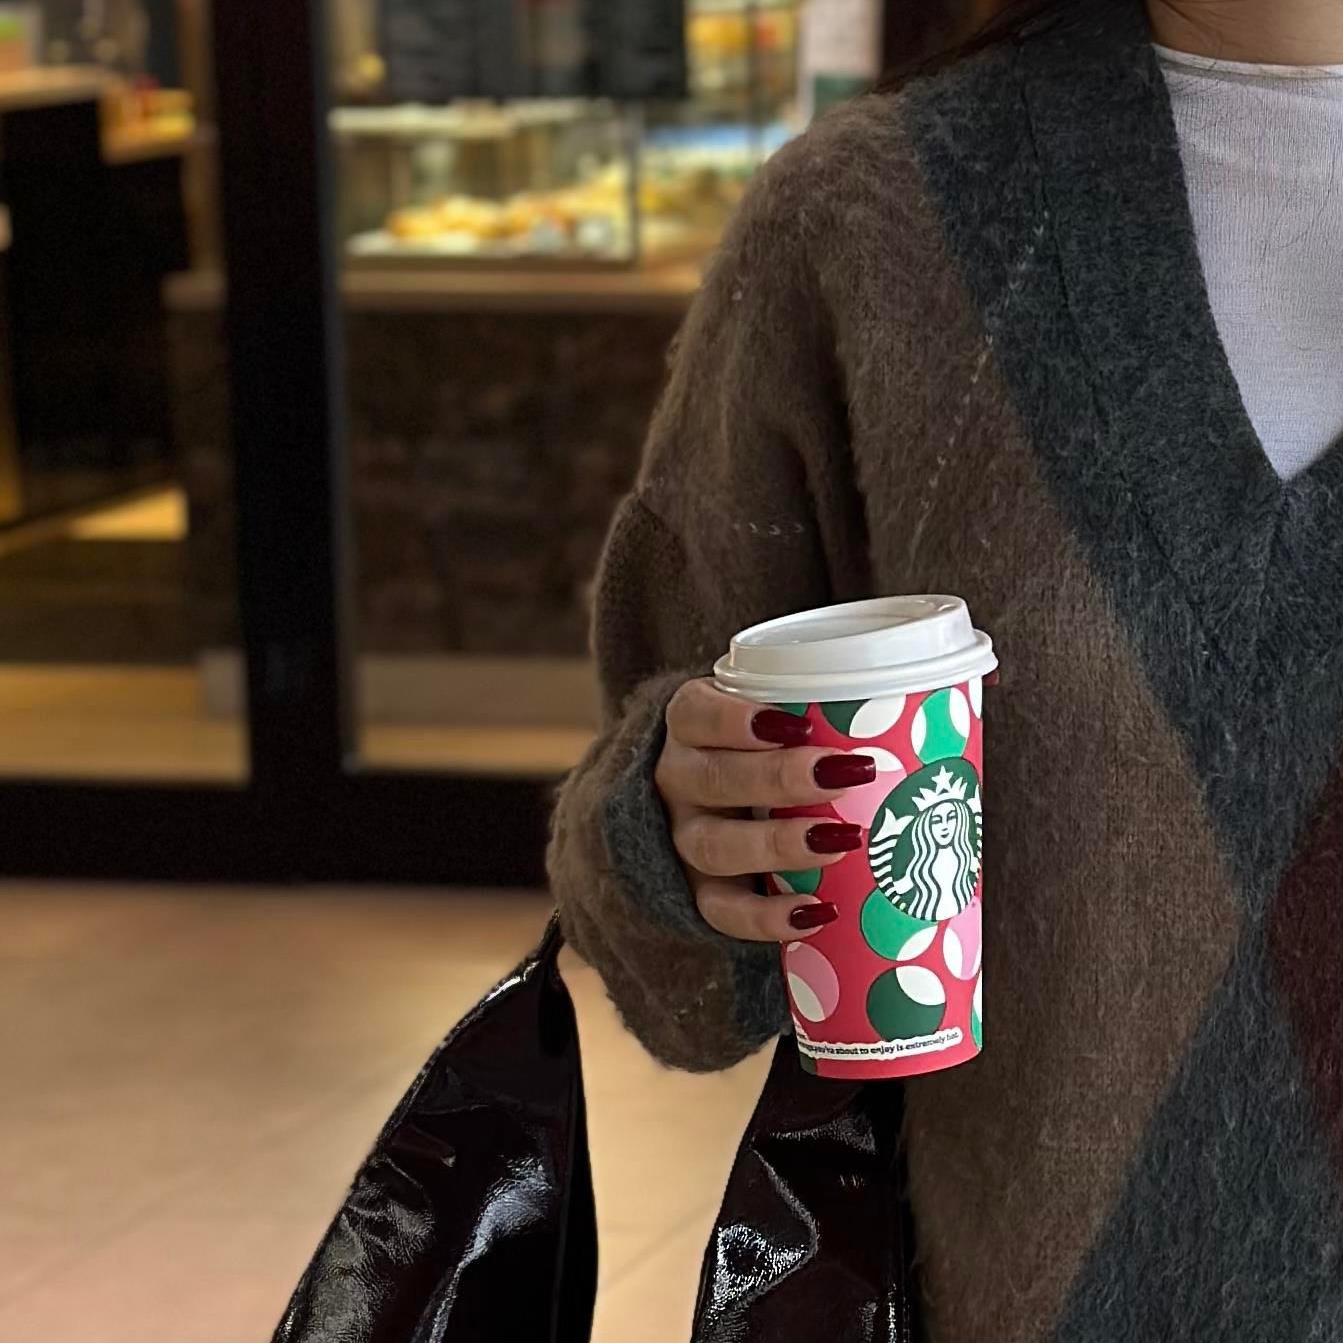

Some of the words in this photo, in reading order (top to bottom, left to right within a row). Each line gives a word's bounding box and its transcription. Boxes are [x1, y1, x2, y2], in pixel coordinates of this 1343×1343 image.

[835, 1046, 858, 1055] about
[870, 1045, 895, 1055] enjoy
[896, 1044, 904, 1052] is
[906, 1036, 945, 1050] extremely
